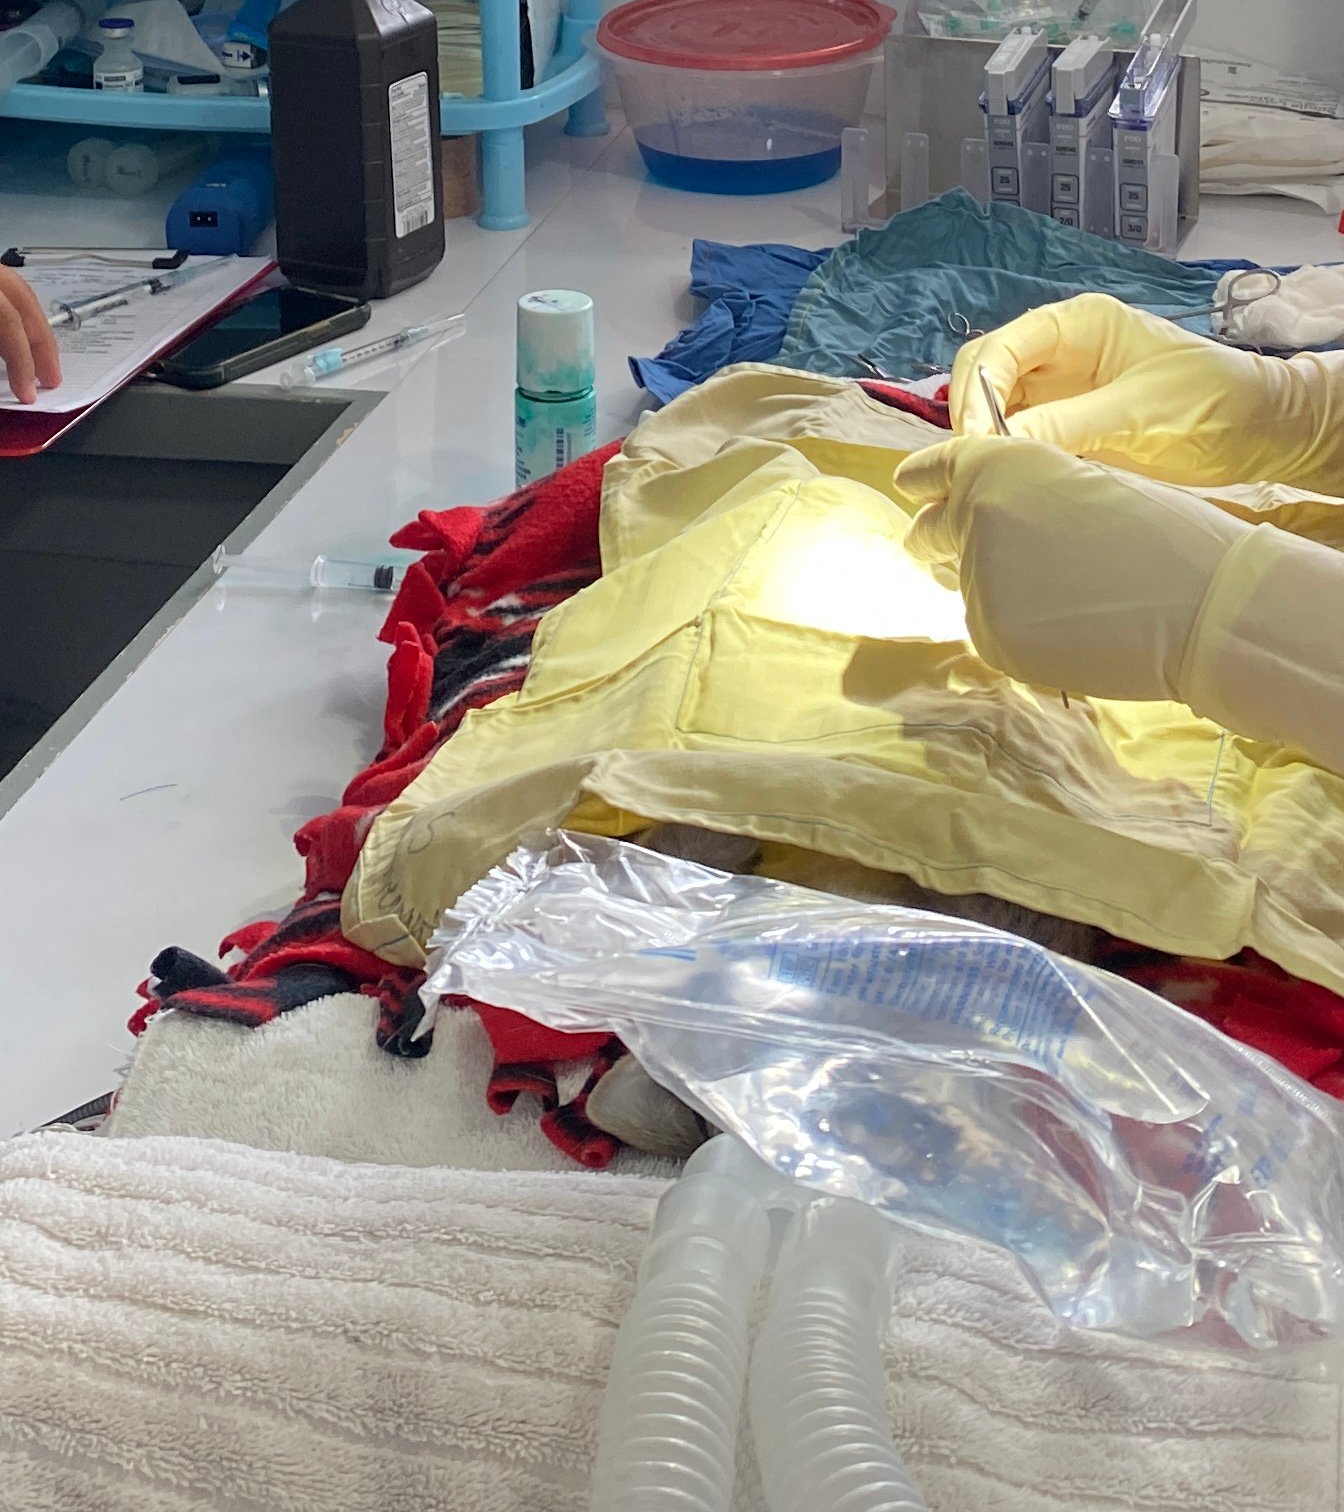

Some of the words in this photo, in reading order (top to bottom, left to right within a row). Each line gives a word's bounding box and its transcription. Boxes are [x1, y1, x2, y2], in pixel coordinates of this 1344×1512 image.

[1000, 175, 1010, 184] 25
[1060, 183, 1071, 192] 25
[1128, 192, 1139, 201] 25
[1127, 224, 1142, 233] 3/0
